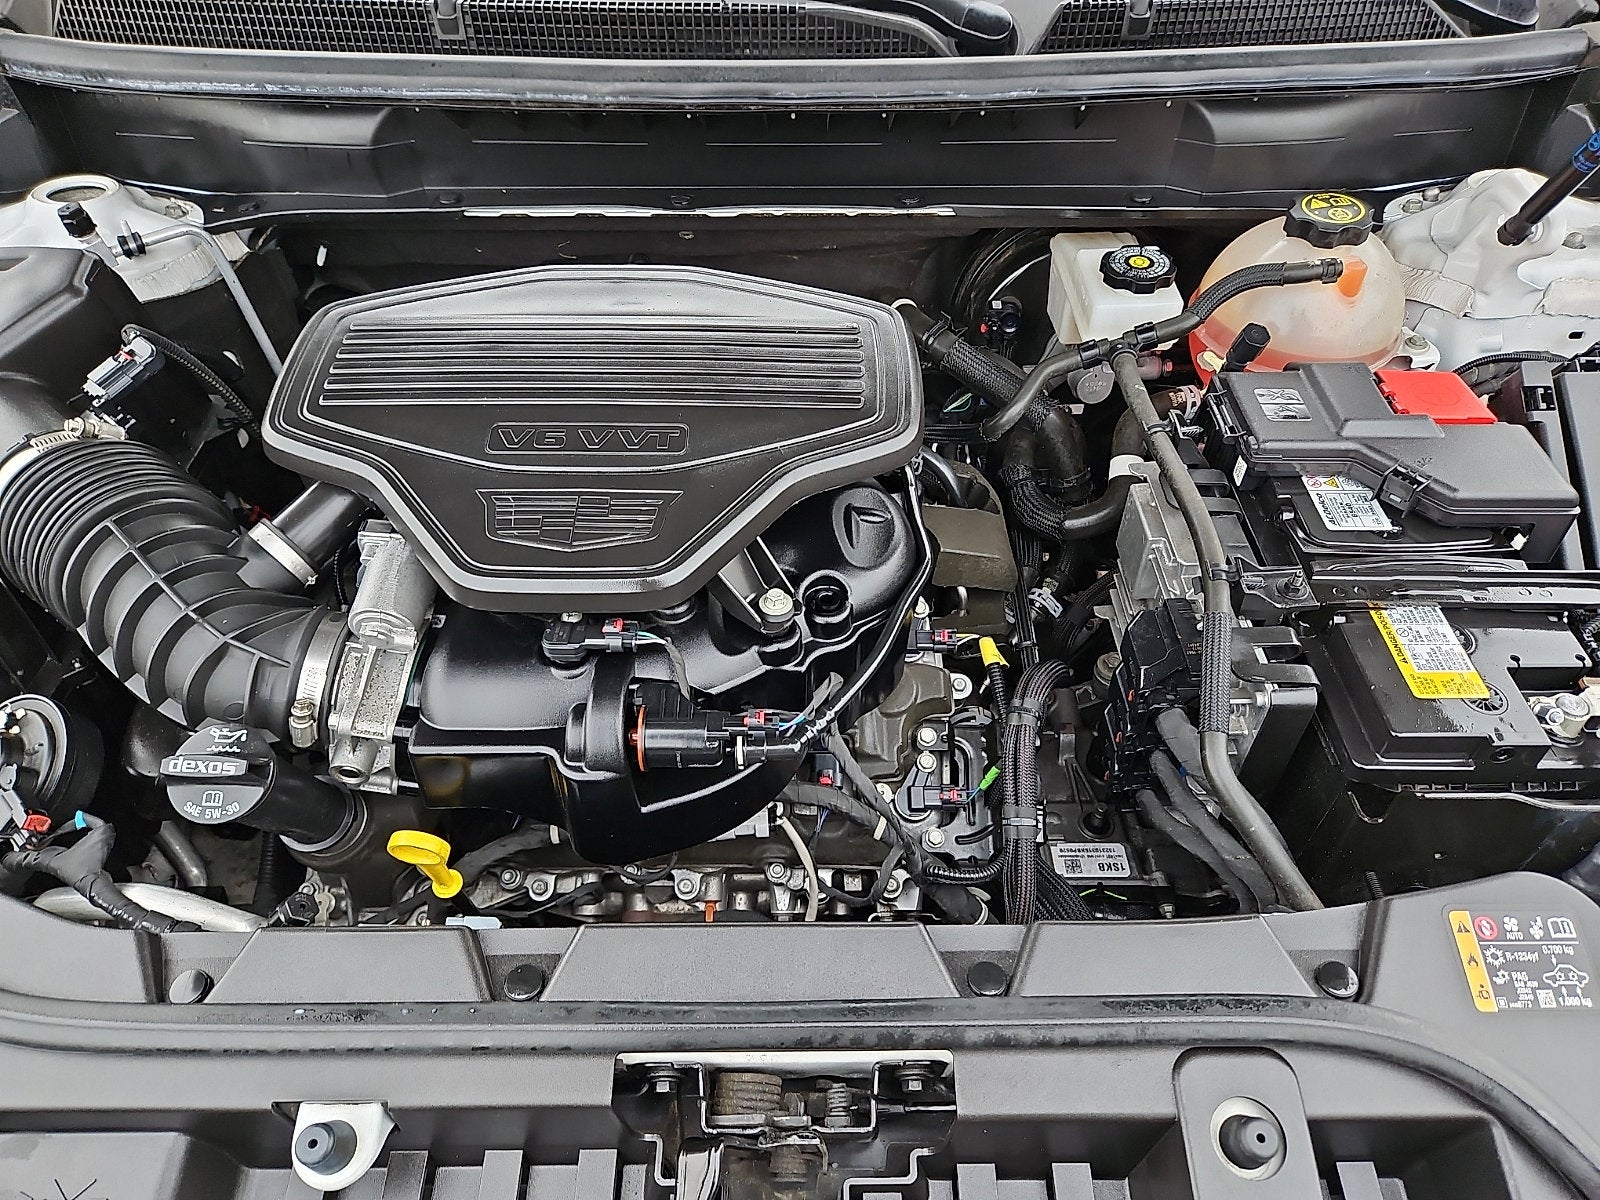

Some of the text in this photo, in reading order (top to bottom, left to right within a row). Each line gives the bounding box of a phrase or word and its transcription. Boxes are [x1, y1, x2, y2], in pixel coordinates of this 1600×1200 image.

[498, 428, 681, 450] V6 VVT
[168, 756, 240, 775] dexos
[183, 801, 240, 819] SAE 5W-30
[1097, 862, 1126, 872] 1SKB
[1506, 931, 1524, 940] AUTO
[1541, 944, 1575, 956] 0.700 kg
[1511, 971, 1528, 982] PAG
